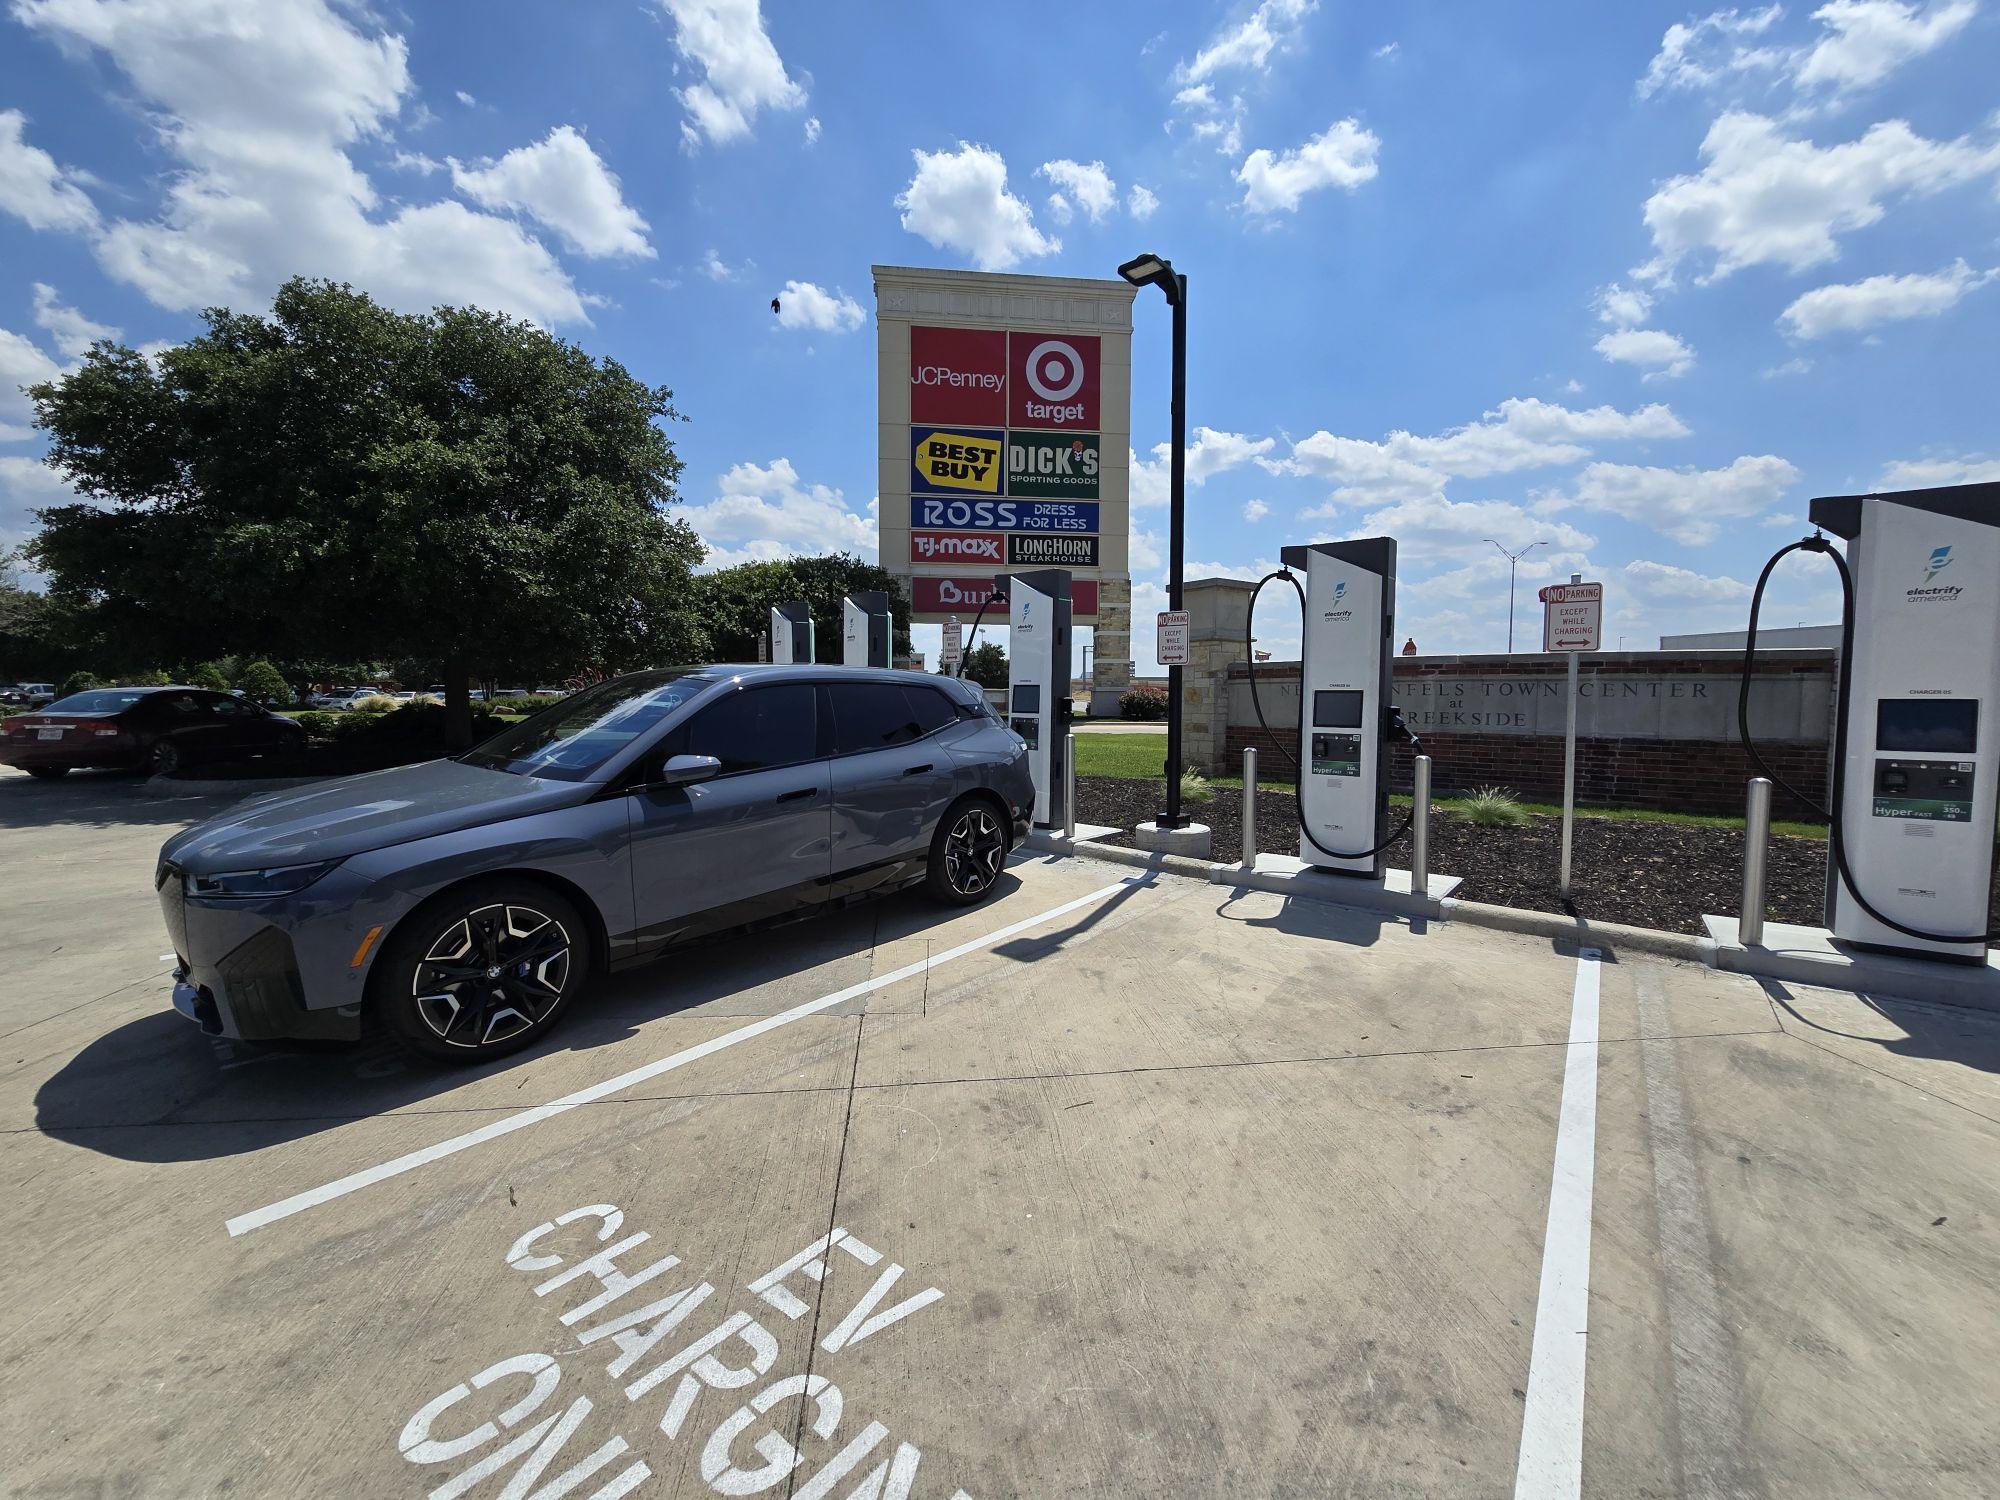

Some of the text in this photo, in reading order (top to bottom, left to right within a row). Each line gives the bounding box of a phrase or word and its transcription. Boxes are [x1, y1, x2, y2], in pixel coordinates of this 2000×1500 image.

[911, 366, 1005, 392] JCPenney
[1026, 401, 1084, 424] target
[928, 441, 997, 465] BEST
[1010, 442, 1098, 475] DICK'S
[930, 460, 990, 482] BUY
[1010, 475, 1098, 485] SPORTING GOODS
[924, 501, 1017, 527] ROSS
[1034, 504, 1076, 516] DRESS
[1023, 517, 1087, 529] FOR LESS
[1015, 537, 1091, 555] LONGHORN
[1015, 555, 1091, 563] STEAKHOUSE
[1550, 588, 1565, 601] NO
[1565, 588, 1599, 599] PARKING
[1907, 586, 1964, 596] electrify
[1907, 594, 1959, 603] america
[1560, 607, 1588, 616] EXCEPT
[1158, 614, 1168, 626] NO
[1562, 617, 1585, 625] WHILE
[1554, 627, 1593, 635] CHARGING
[1281, 684, 1301, 697] NE
[1482, 682, 1560, 698] TOWN
[1578, 682, 1709, 698] CENTER
[1449, 699, 1464, 709] at
[747, 1226, 945, 1354] EV
